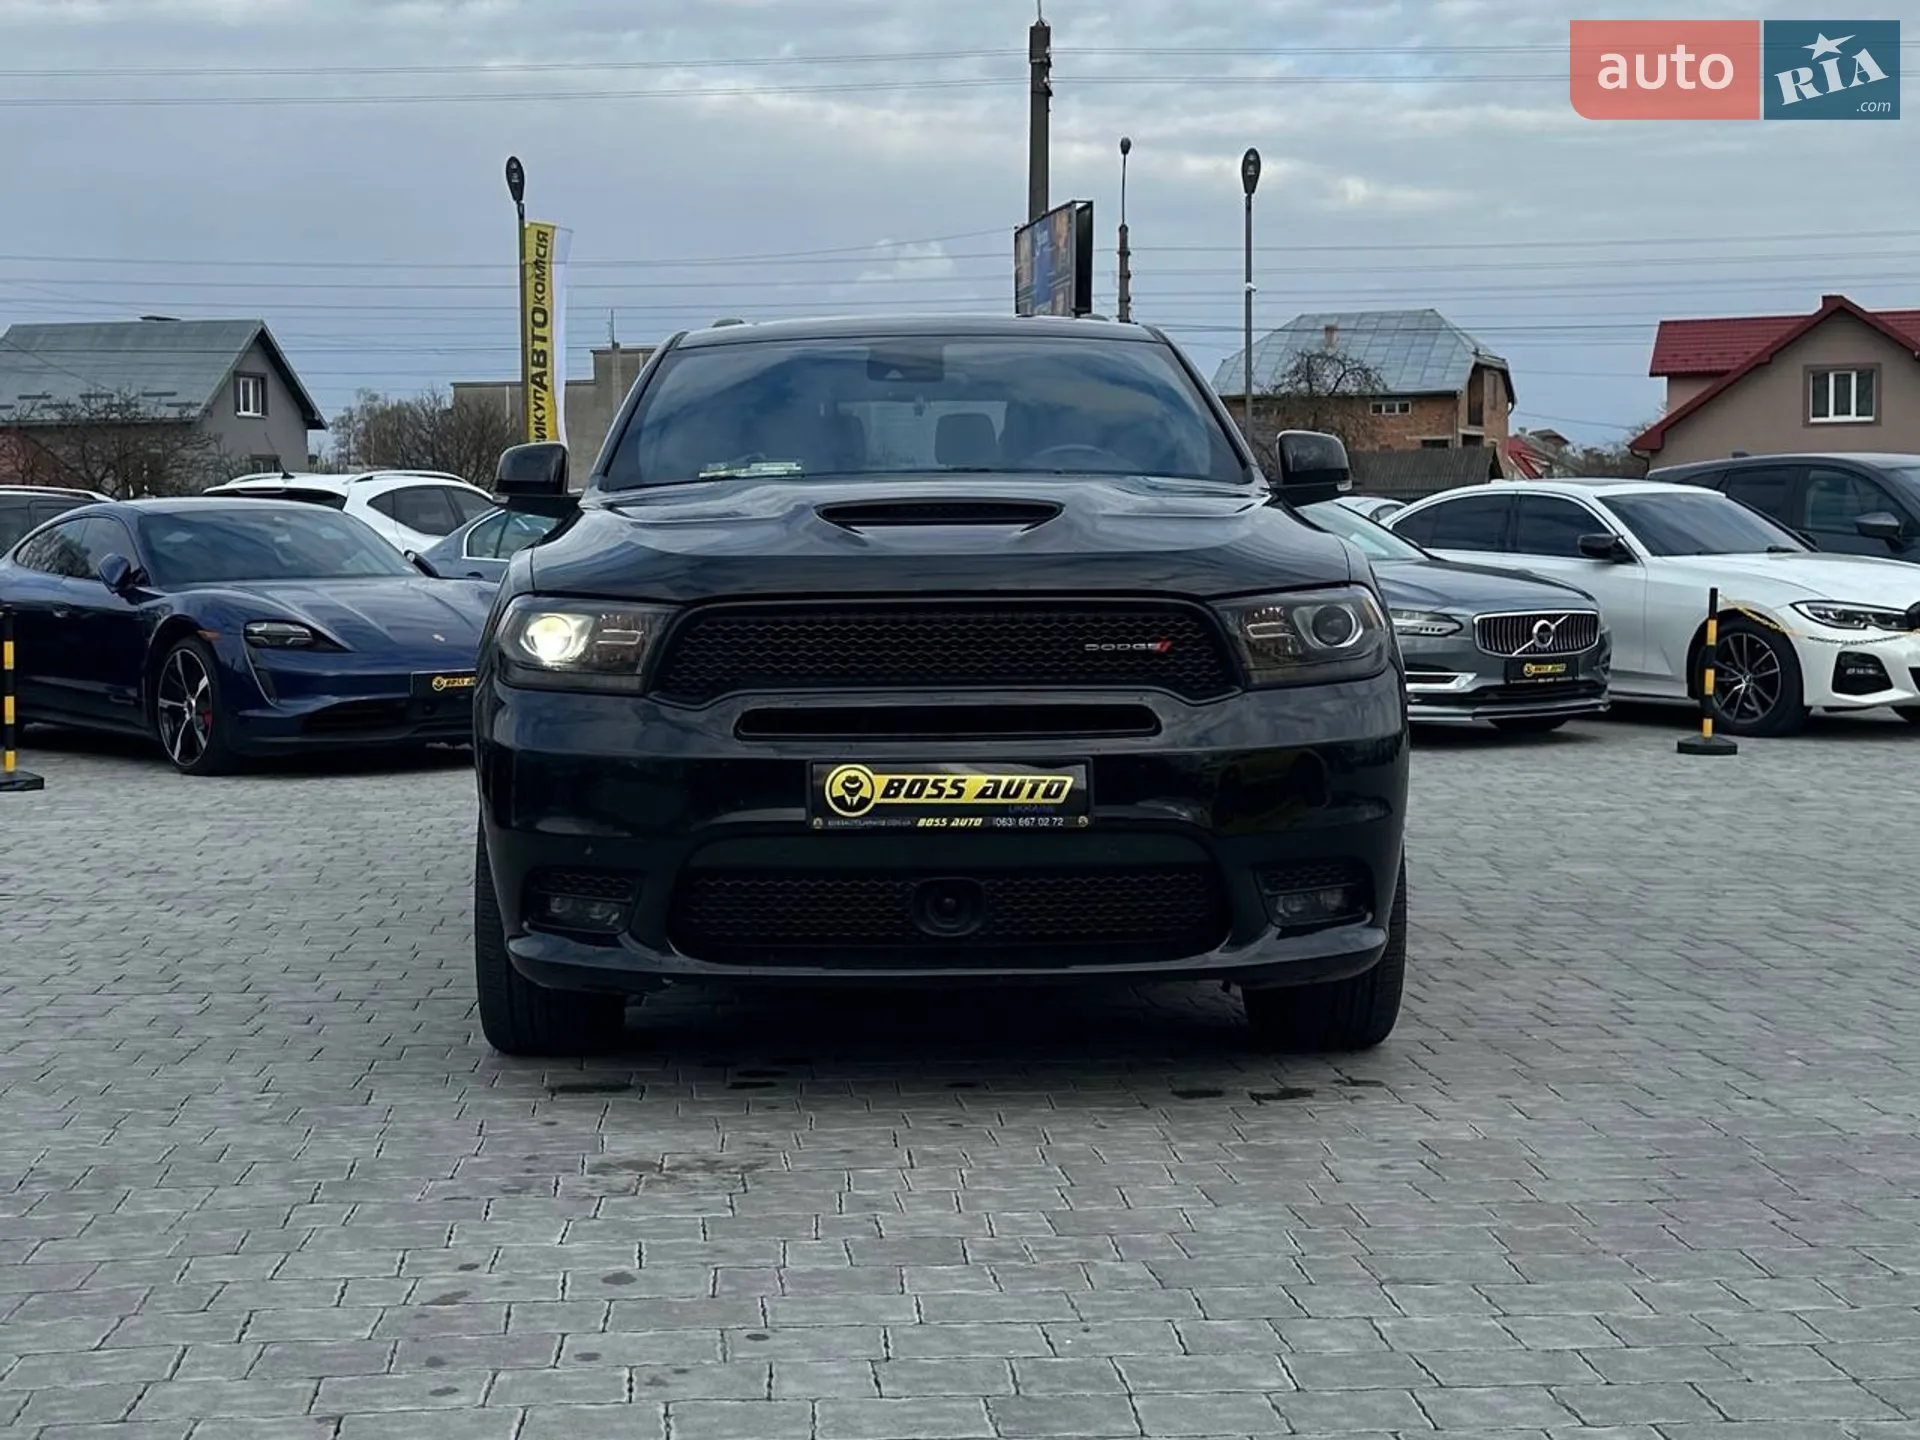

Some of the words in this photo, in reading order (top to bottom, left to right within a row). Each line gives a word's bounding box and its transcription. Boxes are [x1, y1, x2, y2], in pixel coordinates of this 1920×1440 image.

[1084, 643, 1161, 651] DODGE
[880, 778, 968, 800] BOSS
[973, 778, 1068, 800] AUTO
[916, 817, 947, 827] BOSS
[950, 817, 983, 827] AUTO
[1038, 817, 1050, 827] 02
[1052, 817, 1064, 827] 72
